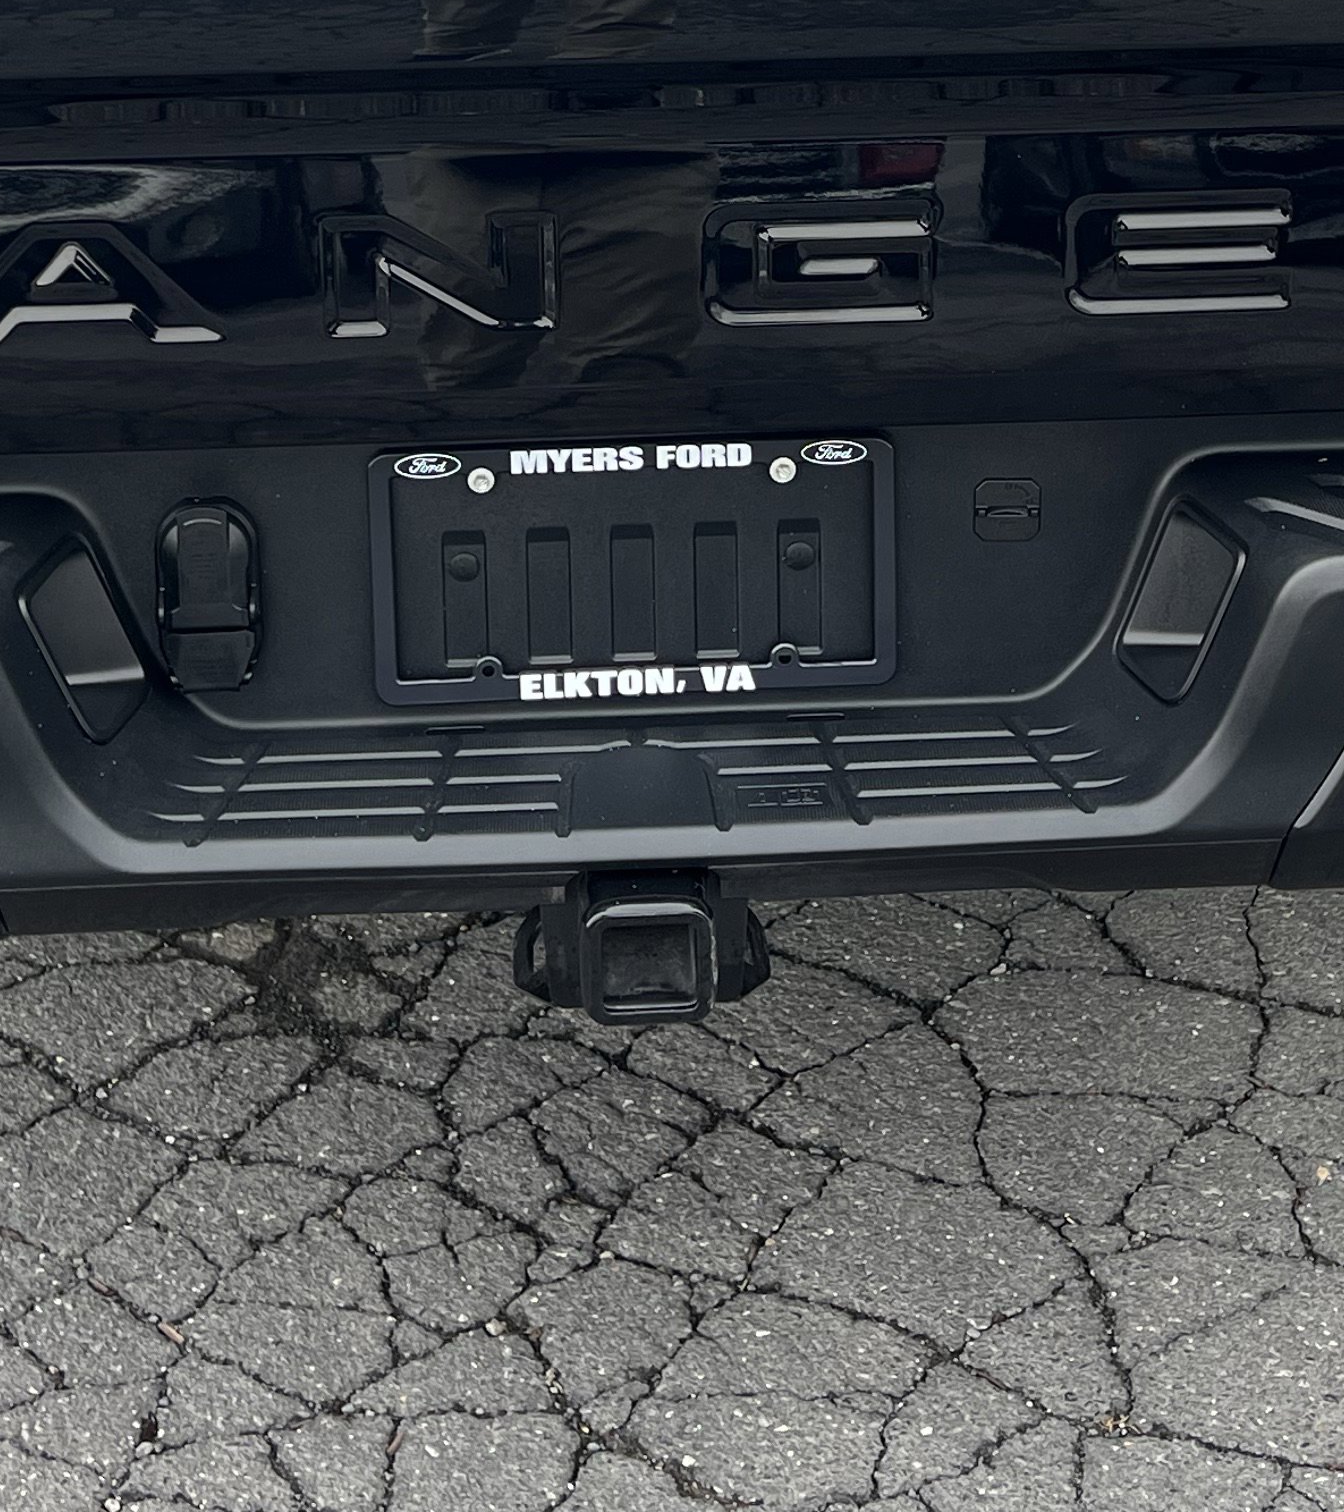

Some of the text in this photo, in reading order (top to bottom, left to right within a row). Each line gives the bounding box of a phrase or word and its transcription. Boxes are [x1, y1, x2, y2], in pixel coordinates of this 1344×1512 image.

[509, 442, 753, 476] MYERS FORD
[519, 664, 757, 701] ELKTON, VA
